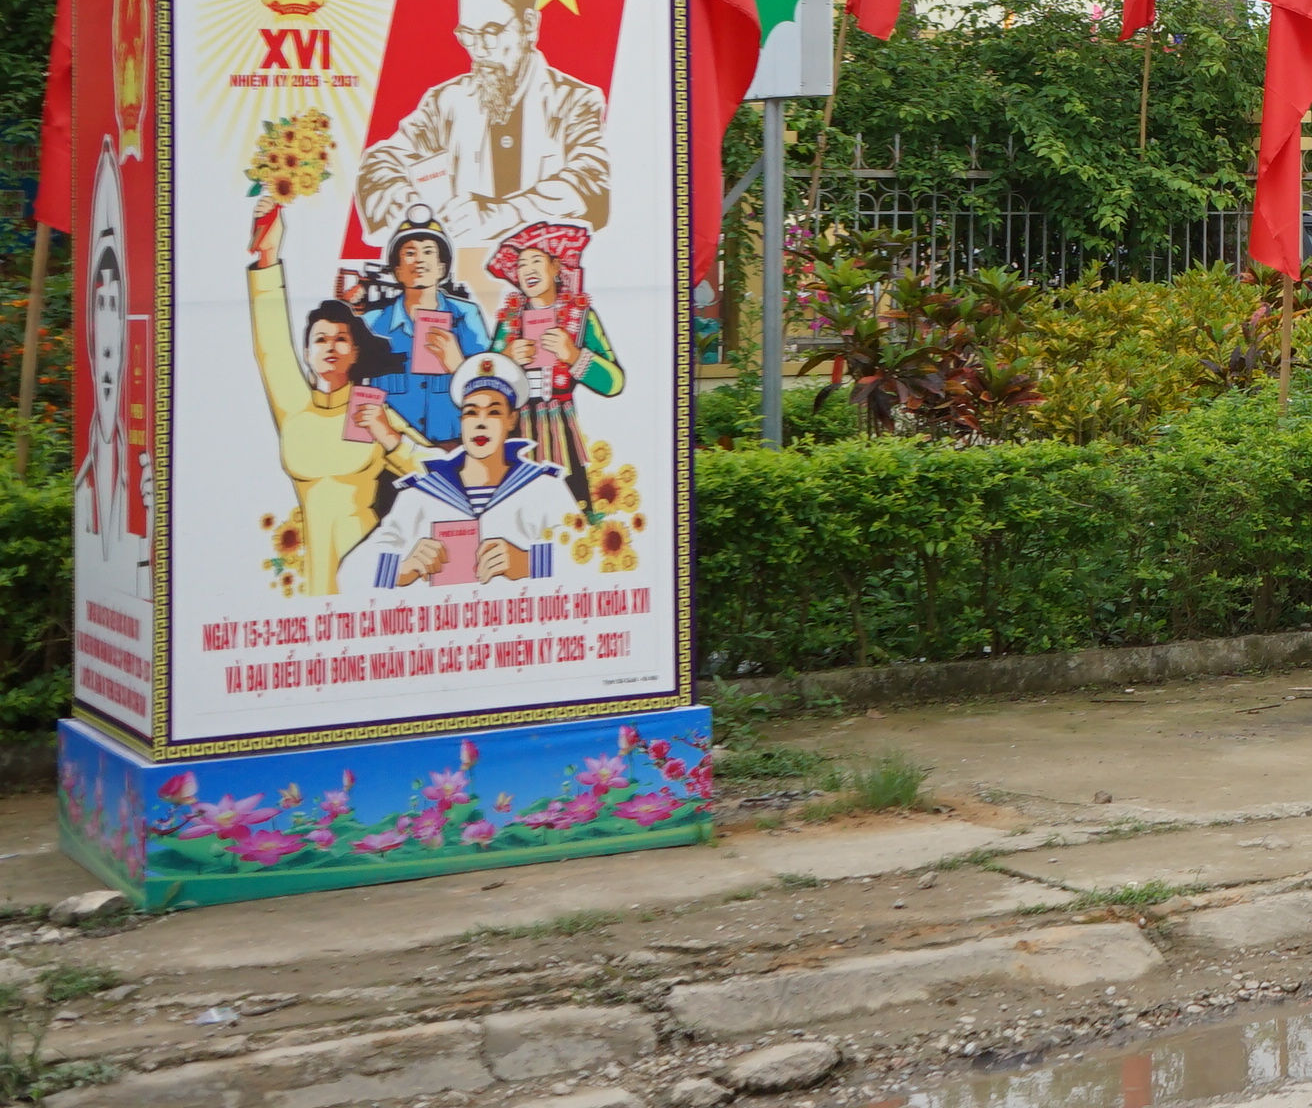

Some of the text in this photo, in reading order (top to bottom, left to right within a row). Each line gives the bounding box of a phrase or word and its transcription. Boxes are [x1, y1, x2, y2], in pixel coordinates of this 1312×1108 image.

[259, 29, 331, 69] XVI
[203, 616, 237, 651] NGÀY
[315, 602, 335, 641] CỬ
[336, 612, 356, 640] TRI
[360, 599, 378, 638] CẢ
[380, 600, 415, 636] NƯỚC
[418, 605, 431, 633] ĐI
[482, 599, 503, 632] ĐẠI
[506, 586, 535, 624] BIỂU
[538, 585, 570, 625] QUỐC
[573, 587, 593, 625] HỘI
[226, 659, 242, 694] VÀ
[247, 663, 267, 698] ĐẠI
[273, 649, 302, 689] BIỂU
[306, 653, 327, 692] HỘI
[369, 646, 404, 680] NHÂN
[409, 643, 435, 676] DÂN
[438, 640, 463, 673] CÁC
[467, 634, 490, 670] CẤP
[495, 634, 534, 673] NHIỆM
